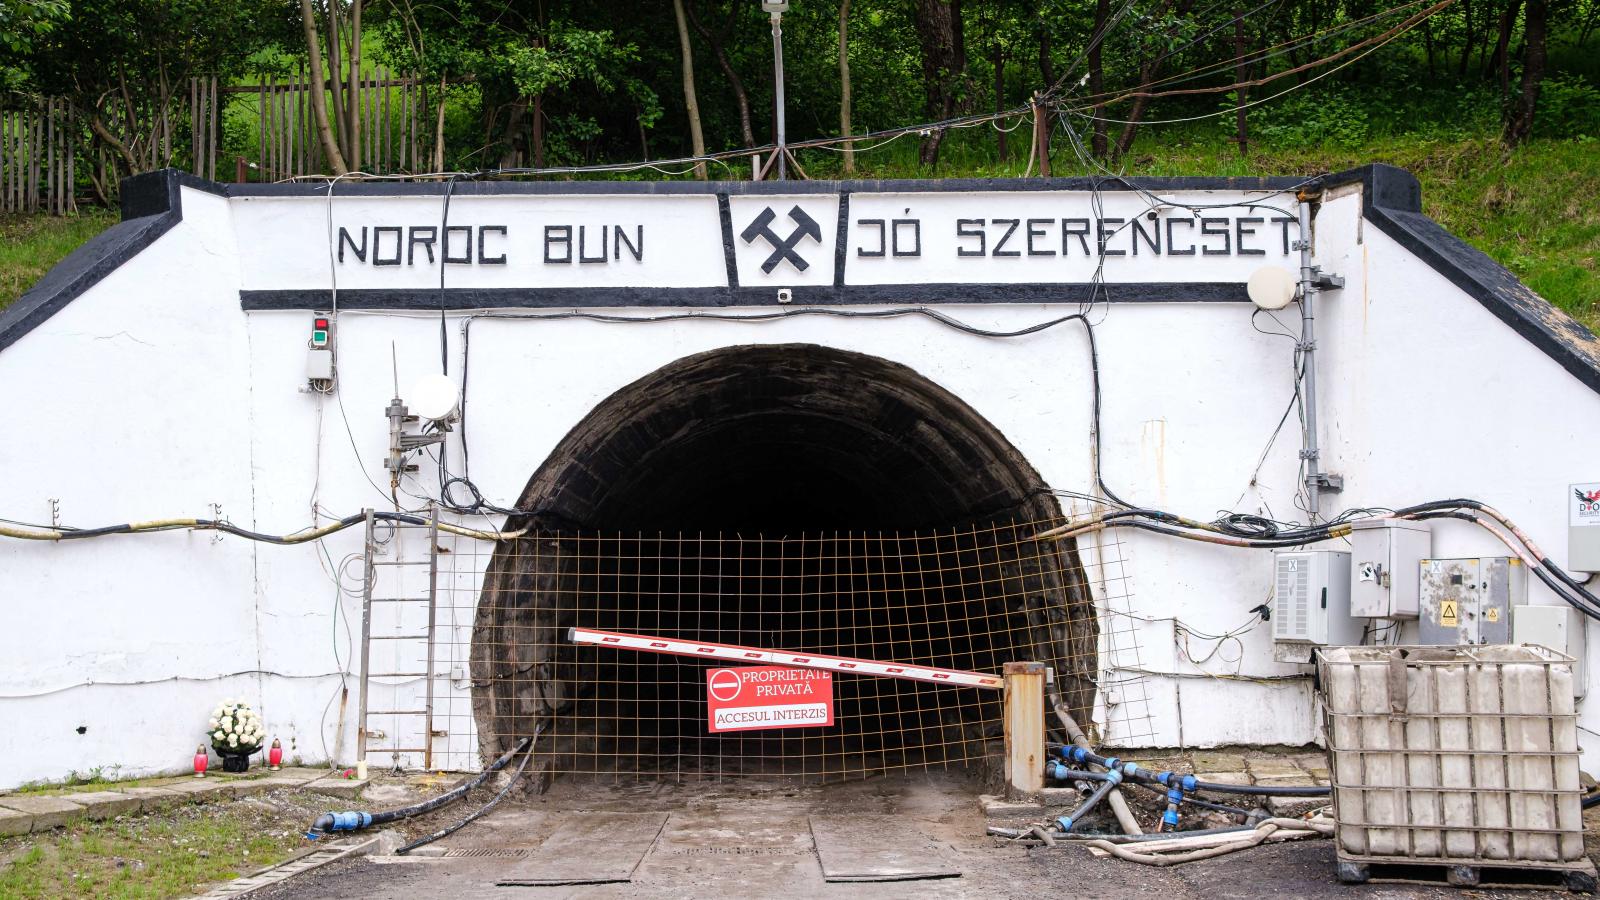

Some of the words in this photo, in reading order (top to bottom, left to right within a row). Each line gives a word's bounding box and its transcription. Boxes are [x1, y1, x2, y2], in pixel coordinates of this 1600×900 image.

[857, 208, 921, 257] JÓ
[957, 205, 1301, 257] SZERENCSÉT
[338, 225, 508, 265] NOROC
[543, 225, 643, 264] BUN
[742, 669, 831, 683] PROPRIETATE
[756, 681, 814, 697] PRIVATĂ
[716, 711, 771, 724] ACCESUL
[773, 708, 826, 720] INTERZIS
